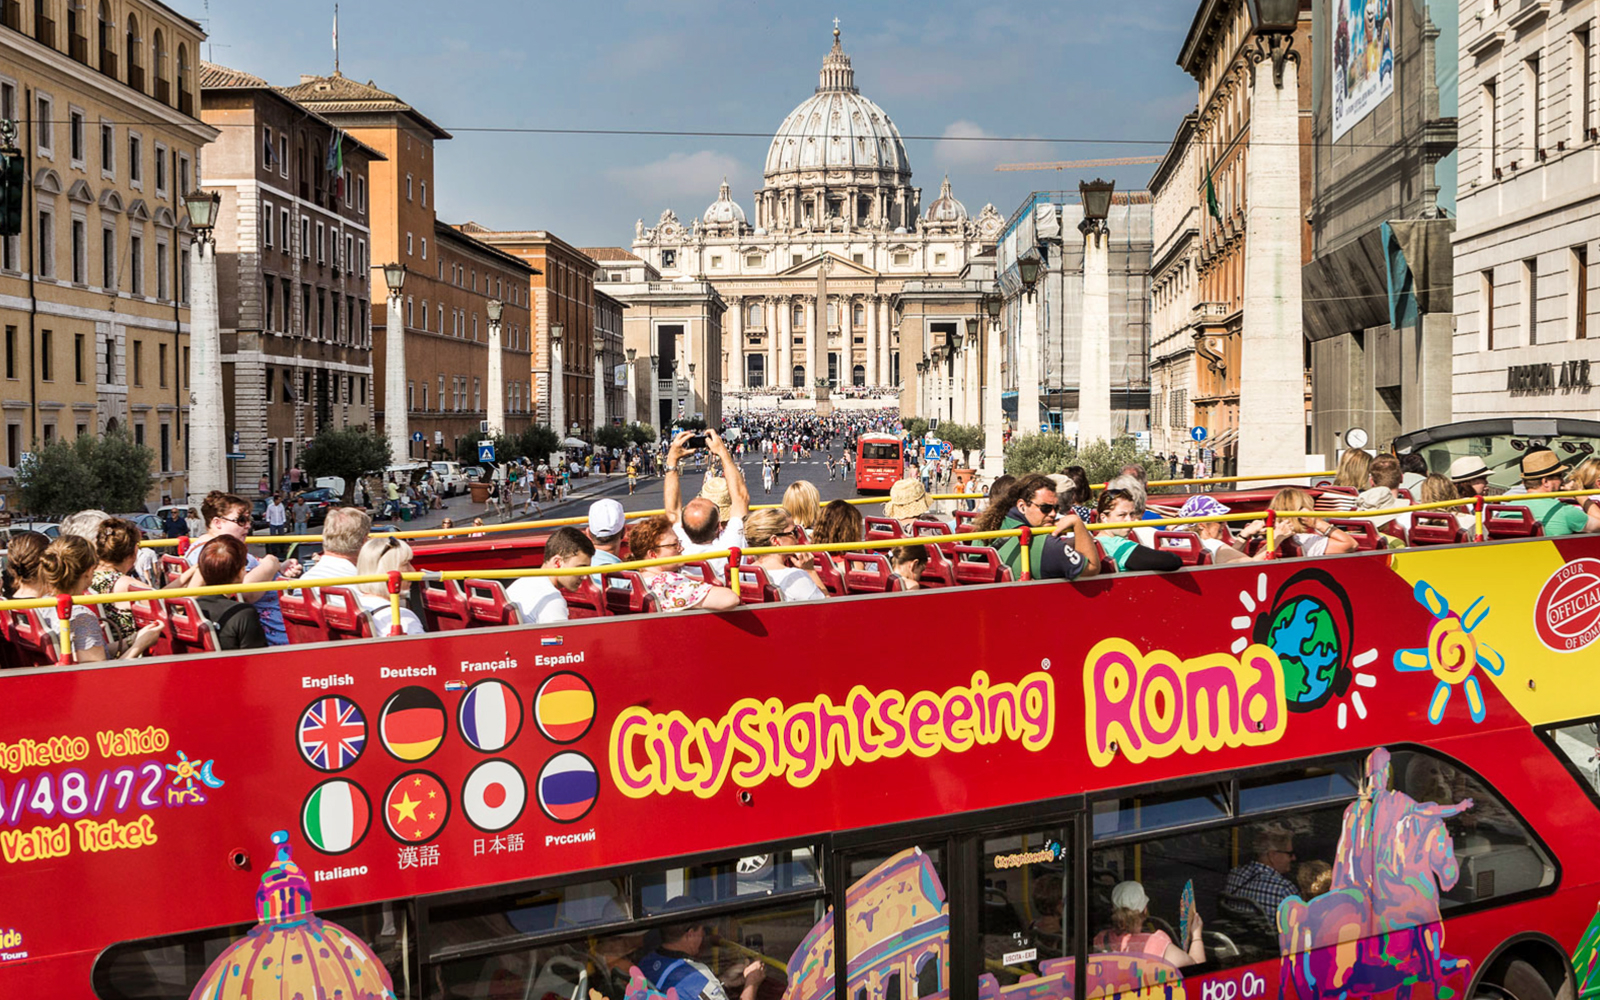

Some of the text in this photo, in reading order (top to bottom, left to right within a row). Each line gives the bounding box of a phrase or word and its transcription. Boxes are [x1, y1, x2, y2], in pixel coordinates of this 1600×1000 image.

[1555, 563, 1584, 583] TOUR
[1565, 621, 1600, 649] OF ROM
[460, 657, 518, 672] Français
[534, 651, 585, 667] Español
[302, 674, 354, 689] English
[380, 665, 437, 679] Deutsch
[97, 726, 170, 758] Valido
[609, 671, 1055, 799] CitySightseeing
[0, 763, 206, 823] /48/72 hrs.
[1, 814, 158, 863] Valid Ticket
[473, 833, 525, 856] 日本語
[397, 844, 440, 870] 漢語
[994, 850, 1055, 869] CitySightseeing
[314, 865, 368, 882] Italiano
[0, 951, 28, 960] Tours
[1005, 953, 1022, 963] USCITA
[1025, 950, 1035, 959] EXIT
[1203, 972, 1265, 1000] Hop On
